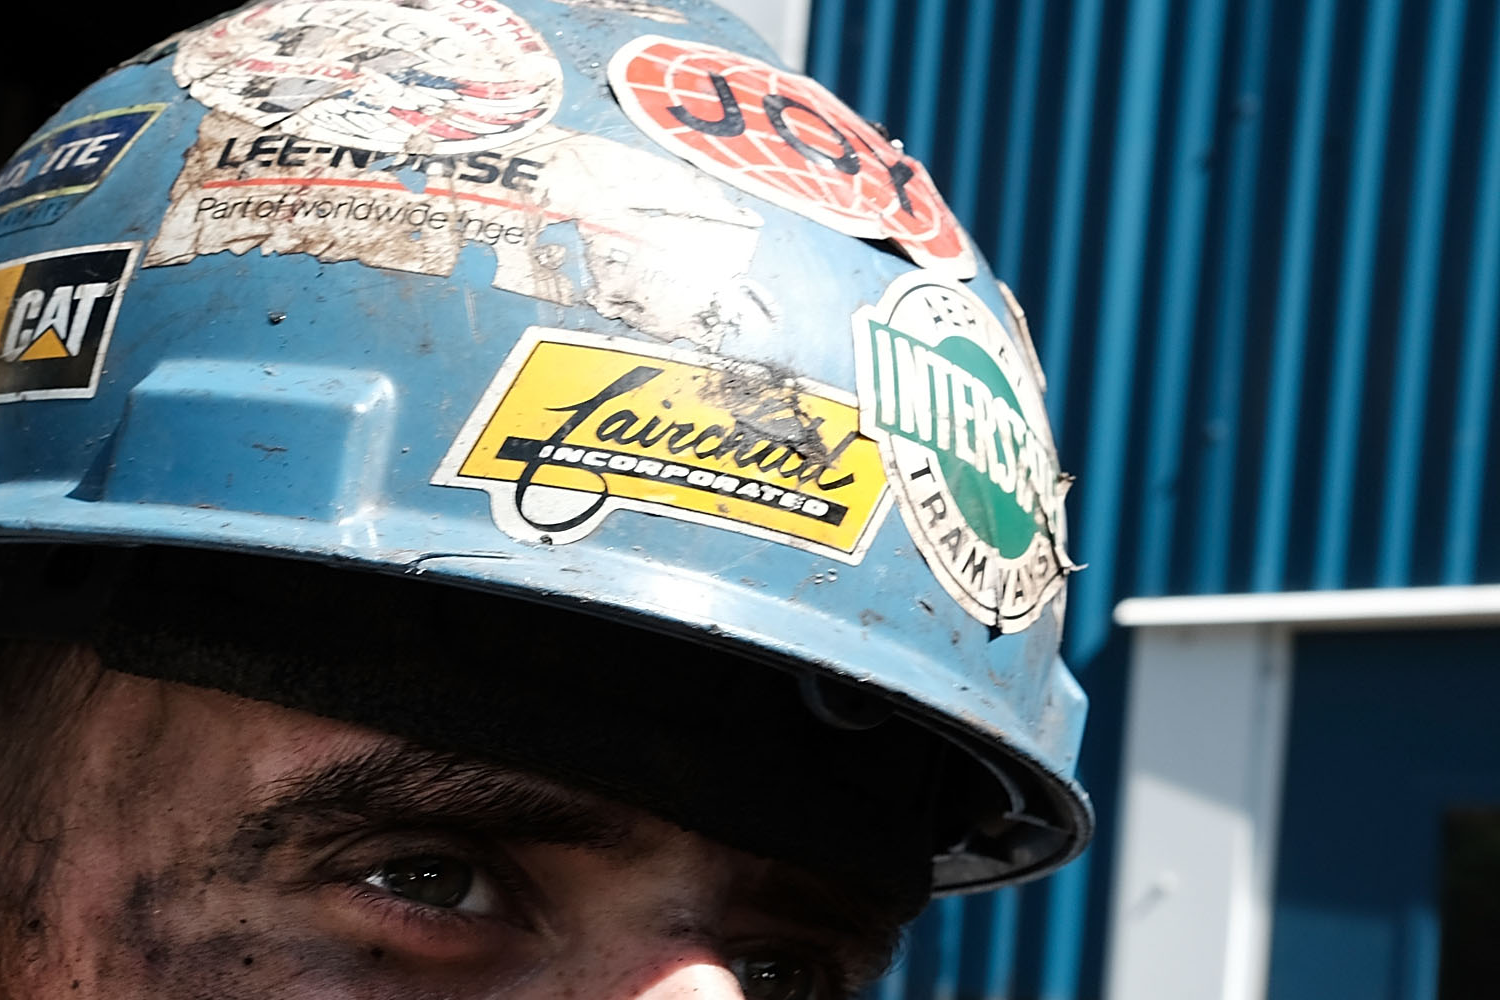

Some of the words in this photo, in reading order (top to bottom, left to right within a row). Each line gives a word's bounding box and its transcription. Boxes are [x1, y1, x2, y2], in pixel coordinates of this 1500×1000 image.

[195, 196, 253, 223] Part
[254, 193, 291, 220] of
[295, 196, 449, 230] worldwide
[2, 282, 109, 363] CAT
[538, 444, 831, 519] INCORPORATED
